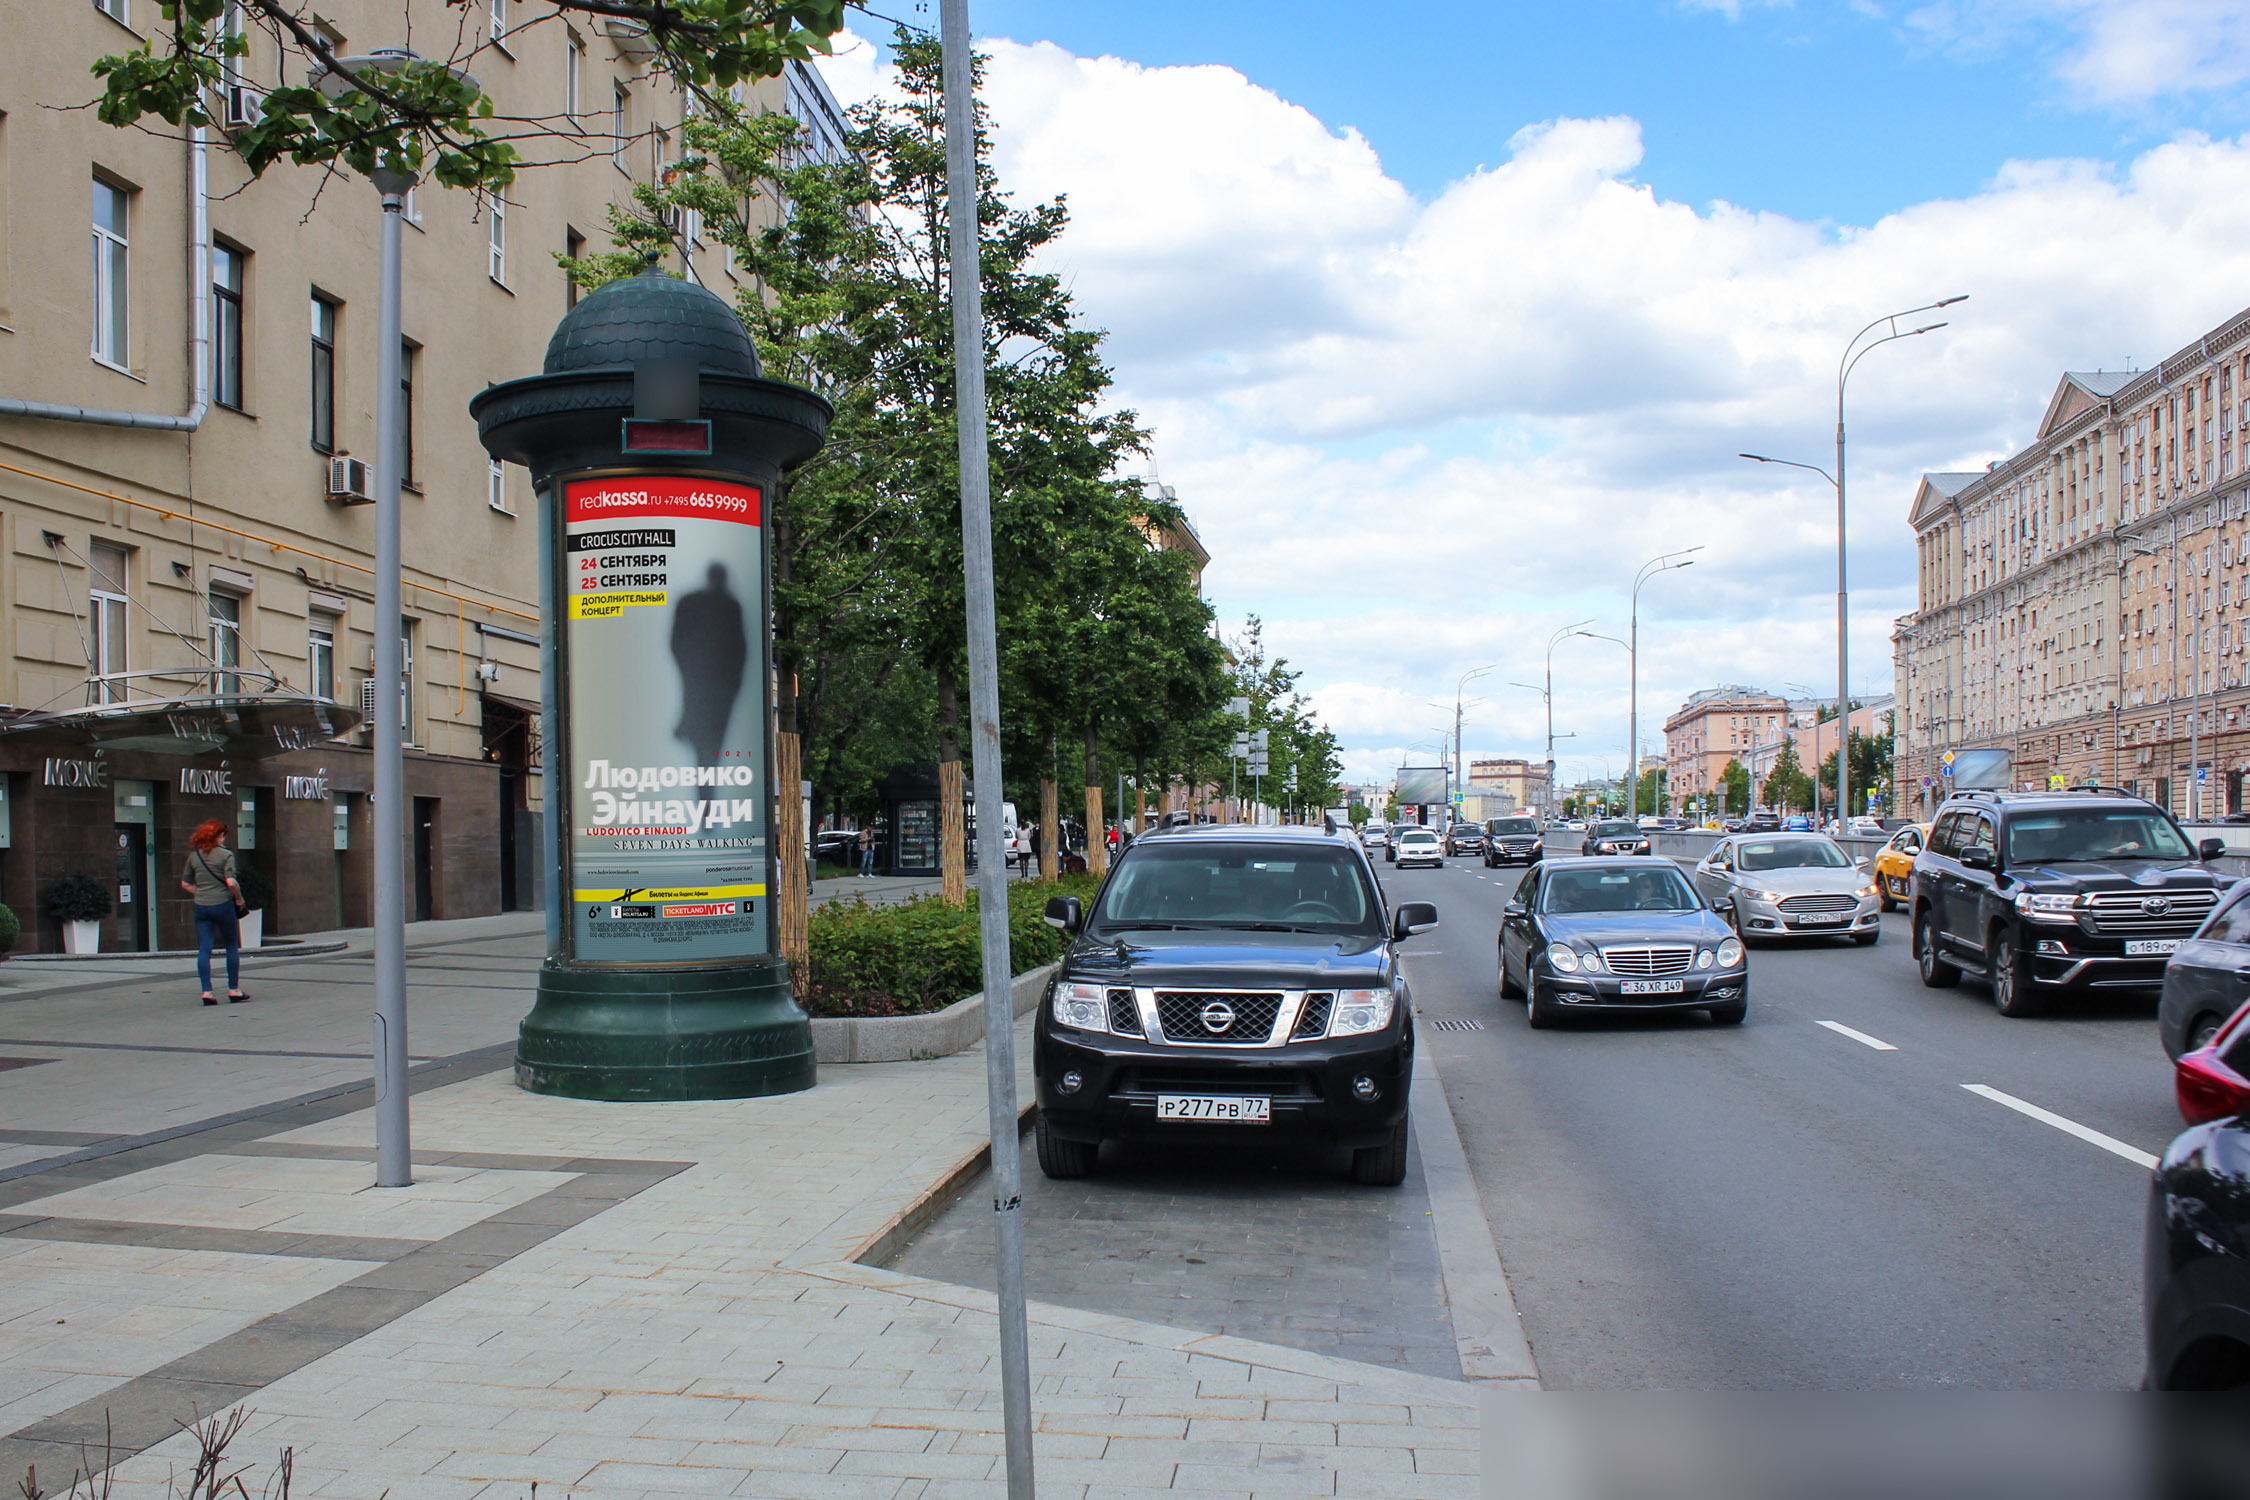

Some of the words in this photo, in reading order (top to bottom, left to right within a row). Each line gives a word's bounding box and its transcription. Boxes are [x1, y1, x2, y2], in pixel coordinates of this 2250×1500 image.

[580, 491, 662, 510] redkassa.ru
[580, 533, 620, 549] CROCUS
[621, 532, 643, 546] CITY
[644, 531, 672, 545] HALL
[581, 557, 597, 570] 24
[600, 554, 666, 568] СЕНТЯБРЯ
[581, 576, 597, 589] 25
[600, 573, 667, 587] СЕНТЯБРЯ
[581, 593, 665, 606] ДОПОЛНИТЕЛЬНЫЙ
[581, 606, 620, 616] КОНЦЕРТ
[584, 759, 753, 792] Людовико
[592, 790, 753, 834] Эйнауди
[586, 827, 641, 836] LUDOVICO
[644, 826, 687, 835] EINAUDI
[613, 841, 654, 850] SEVEN
[660, 839, 691, 849] DAYS
[588, 905, 602, 919] 6+
[665, 907, 704, 915] TICKETLAND
[1633, 982, 1645, 992] 36
[1648, 982, 1661, 992] XR
[1664, 980, 1681, 991] 149
[1245, 1099, 1263, 1113] 77
